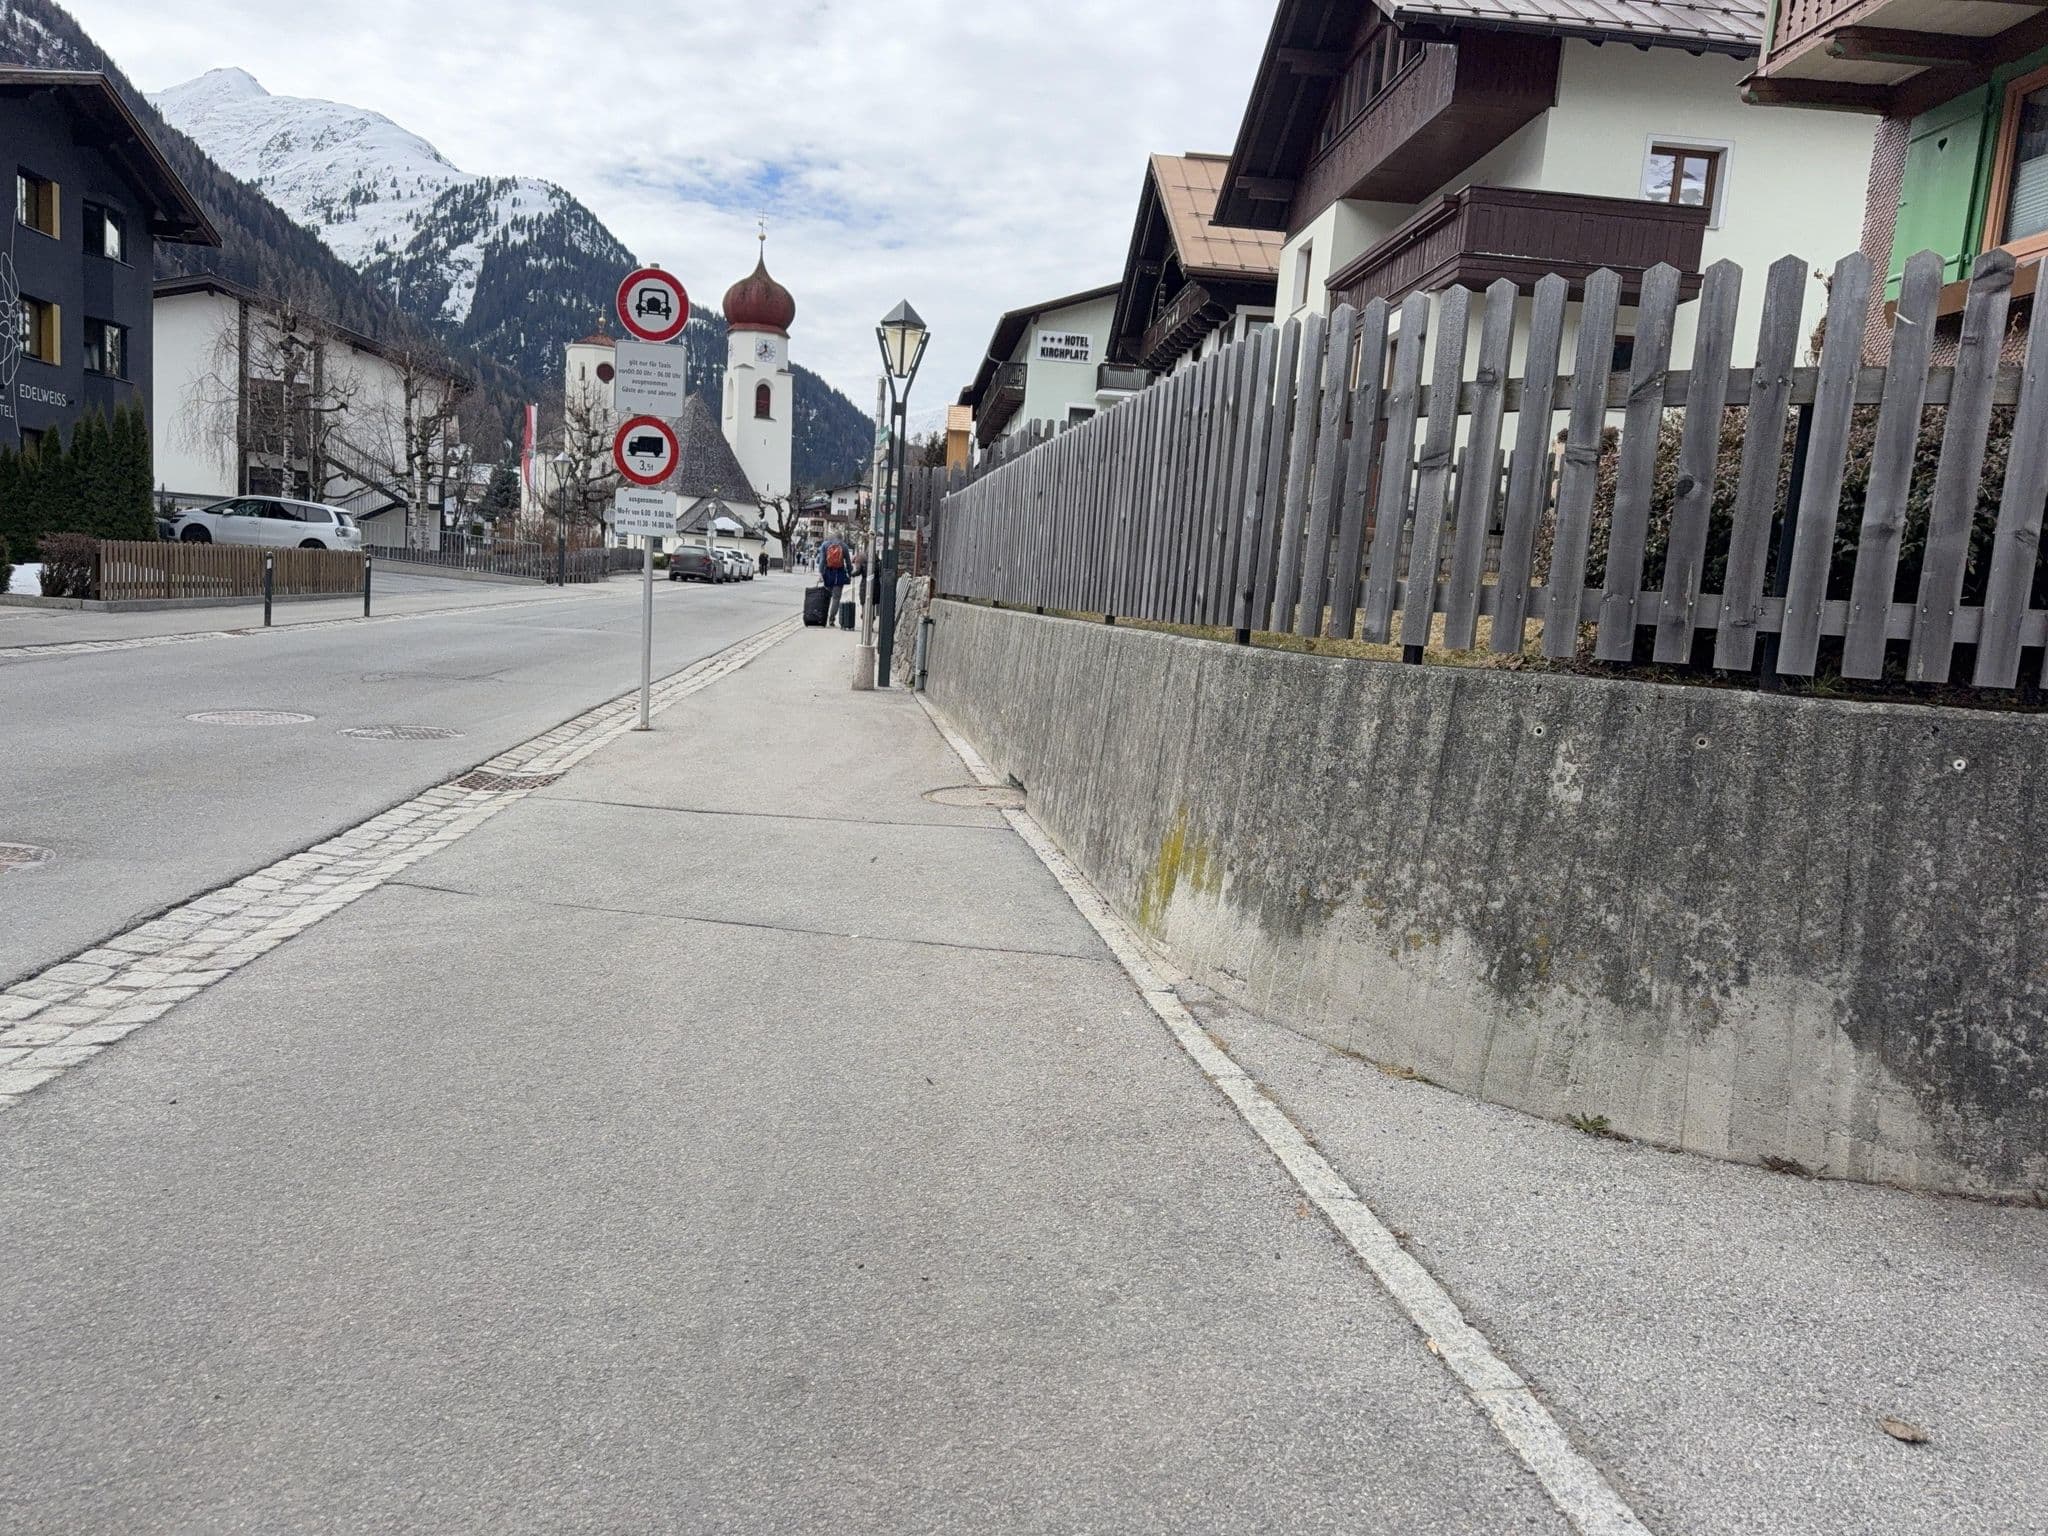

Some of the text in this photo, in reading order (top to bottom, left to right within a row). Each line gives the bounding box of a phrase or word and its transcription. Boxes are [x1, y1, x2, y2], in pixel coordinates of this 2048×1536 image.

[1064, 335, 1089, 347] HOTEL
[1041, 347, 1089, 361] KIRCHPLATZ
[20, 384, 67, 407] EDELWEISS
[665, 511, 674, 519] Uhr
[665, 522, 674, 530] Uhr
